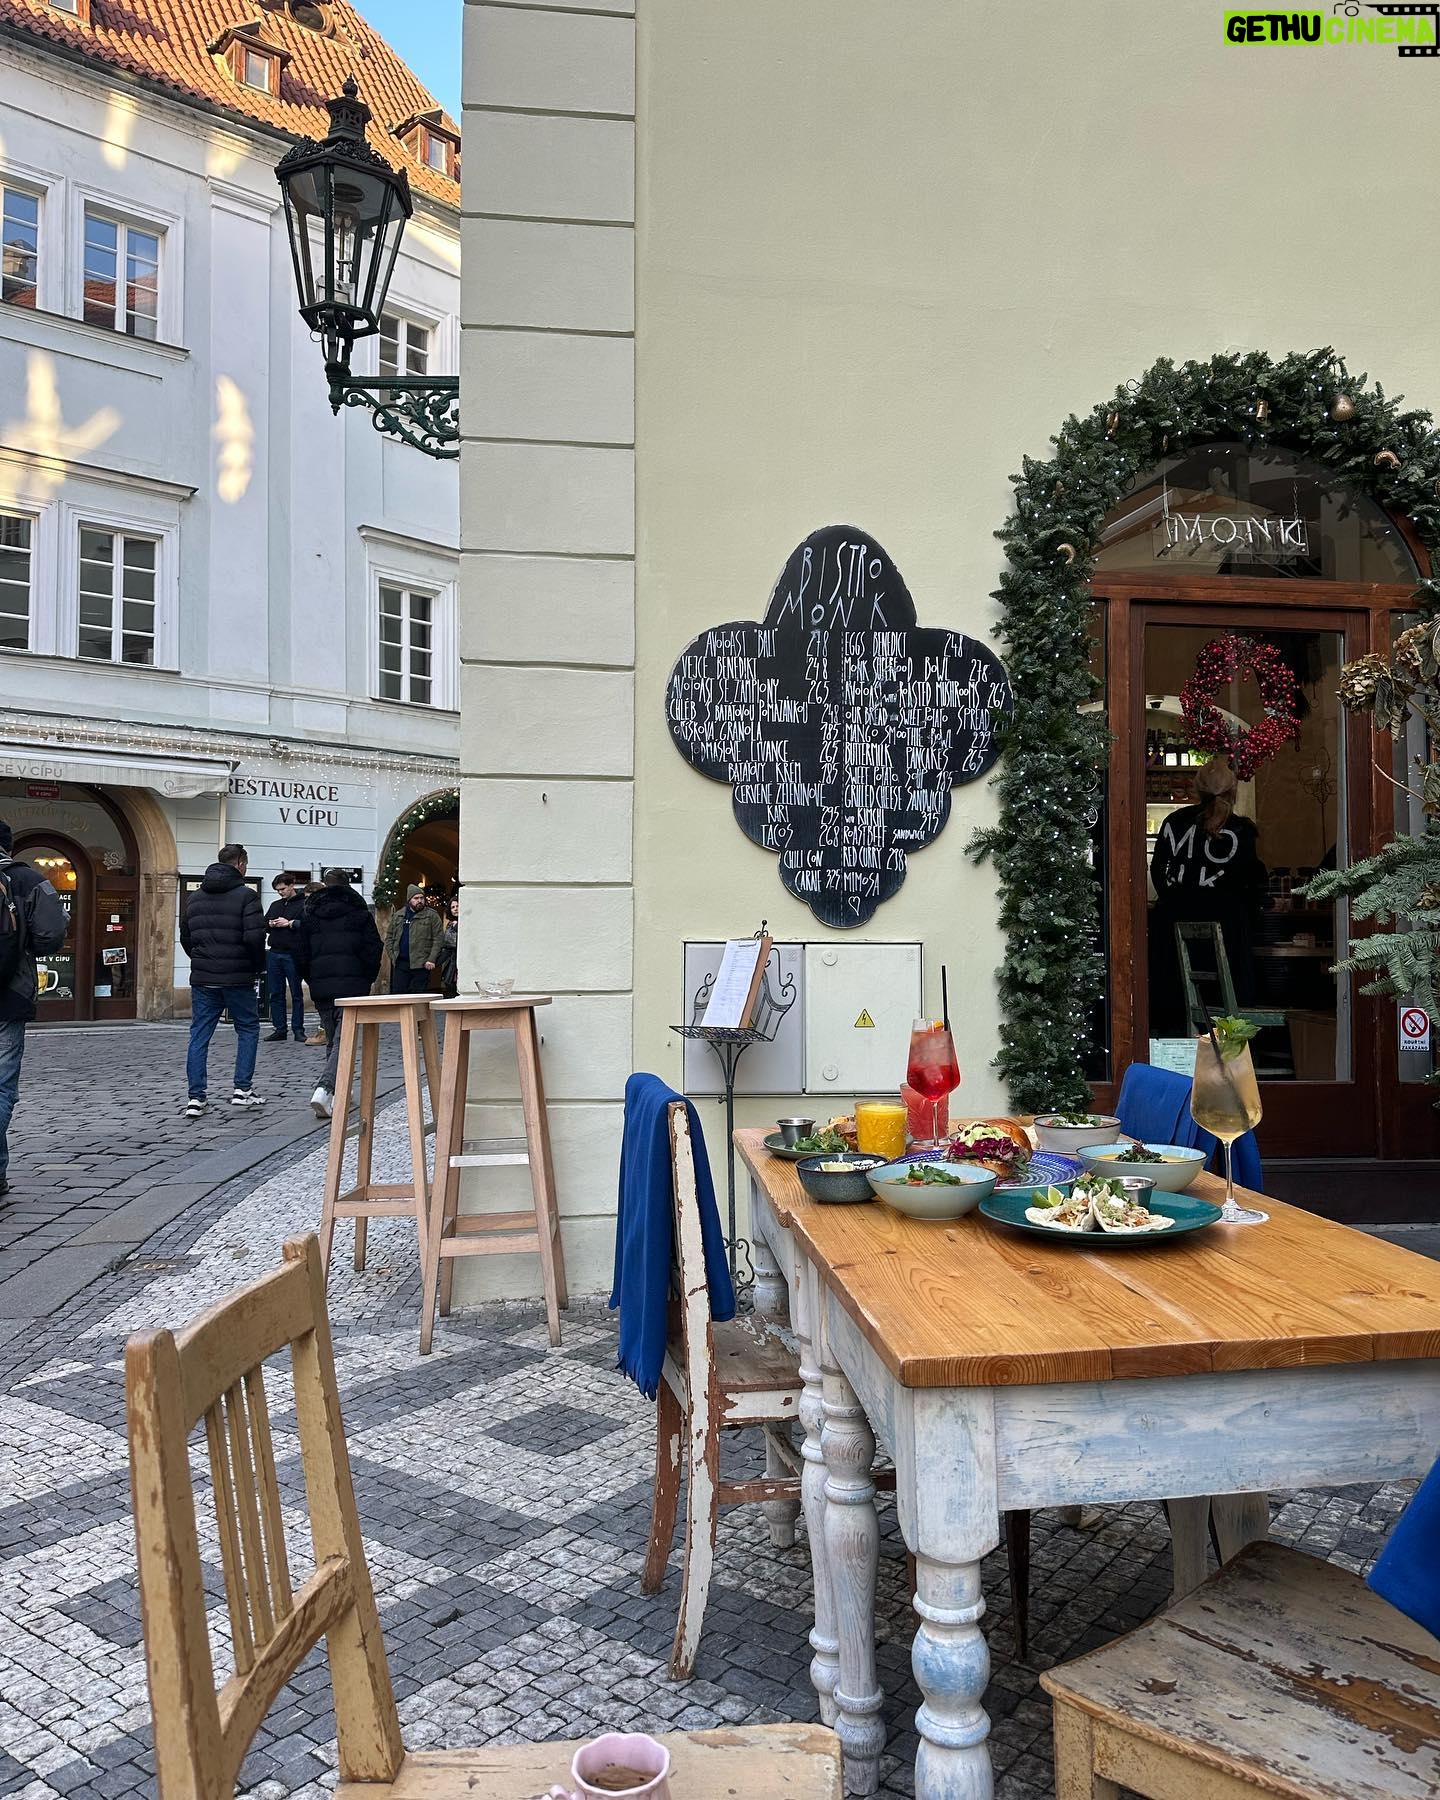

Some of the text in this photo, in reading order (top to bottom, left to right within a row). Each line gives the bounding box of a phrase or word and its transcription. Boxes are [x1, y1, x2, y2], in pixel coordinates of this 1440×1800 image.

[1166, 513, 1307, 546] MONK
[800, 541, 882, 604] BISTRO
[777, 591, 888, 630] MONK
[705, 630, 747, 657] AVOTOAST
[845, 631, 964, 660] EGGS BENEDICT 248
[682, 656, 828, 680] VEJCE BENEDIKT 248
[925, 656, 950, 682] BOWL
[718, 679, 730, 704] SE
[807, 680, 830, 704] 265
[987, 682, 1005, 709] 265
[821, 703, 839, 725] 248
[846, 706, 863, 725] OUR
[820, 722, 841, 741] 185
[845, 723, 878, 743] MANGO
[820, 740, 841, 763] 265
[845, 743, 892, 767] BUTTERMILK
[962, 749, 988, 774] 265
[17, 765, 27, 775] V
[821, 762, 840, 784] 185
[279, 805, 339, 826] V CÍPU
[767, 805, 789, 823] KARI
[920, 811, 940, 833] 315
[760, 824, 840, 848] TACOS 268
[1163, 822, 1238, 864] MO
[783, 849, 823, 869] CHILI CON
[843, 846, 859, 867] RED
[859, 846, 882, 870] CURRY
[794, 870, 822, 892] CARNE
[844, 872, 880, 898] MIMOSA
